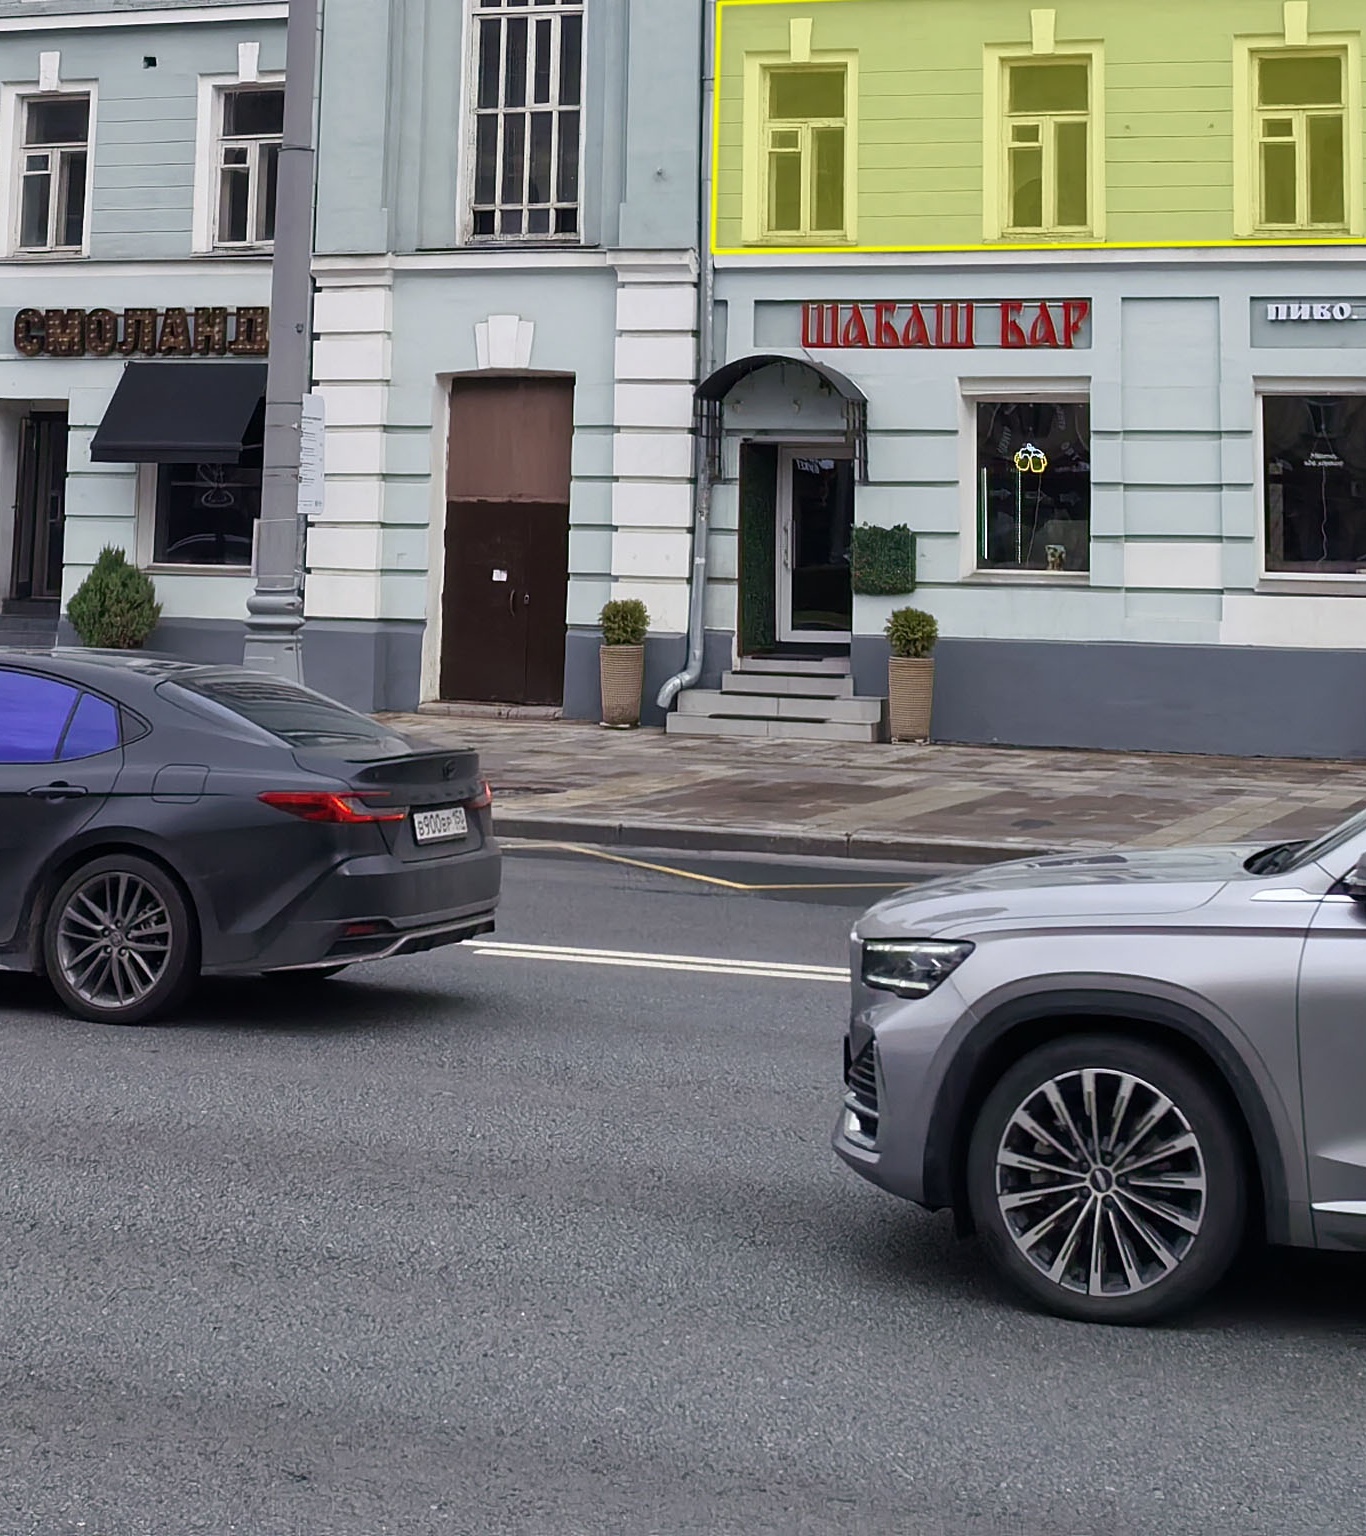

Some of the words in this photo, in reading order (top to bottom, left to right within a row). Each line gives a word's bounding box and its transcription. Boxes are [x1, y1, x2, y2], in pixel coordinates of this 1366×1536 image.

[14, 307, 270, 357] СМОЛАНД
[801, 302, 975, 349] ШАБАШ
[1000, 301, 1090, 349] БАР
